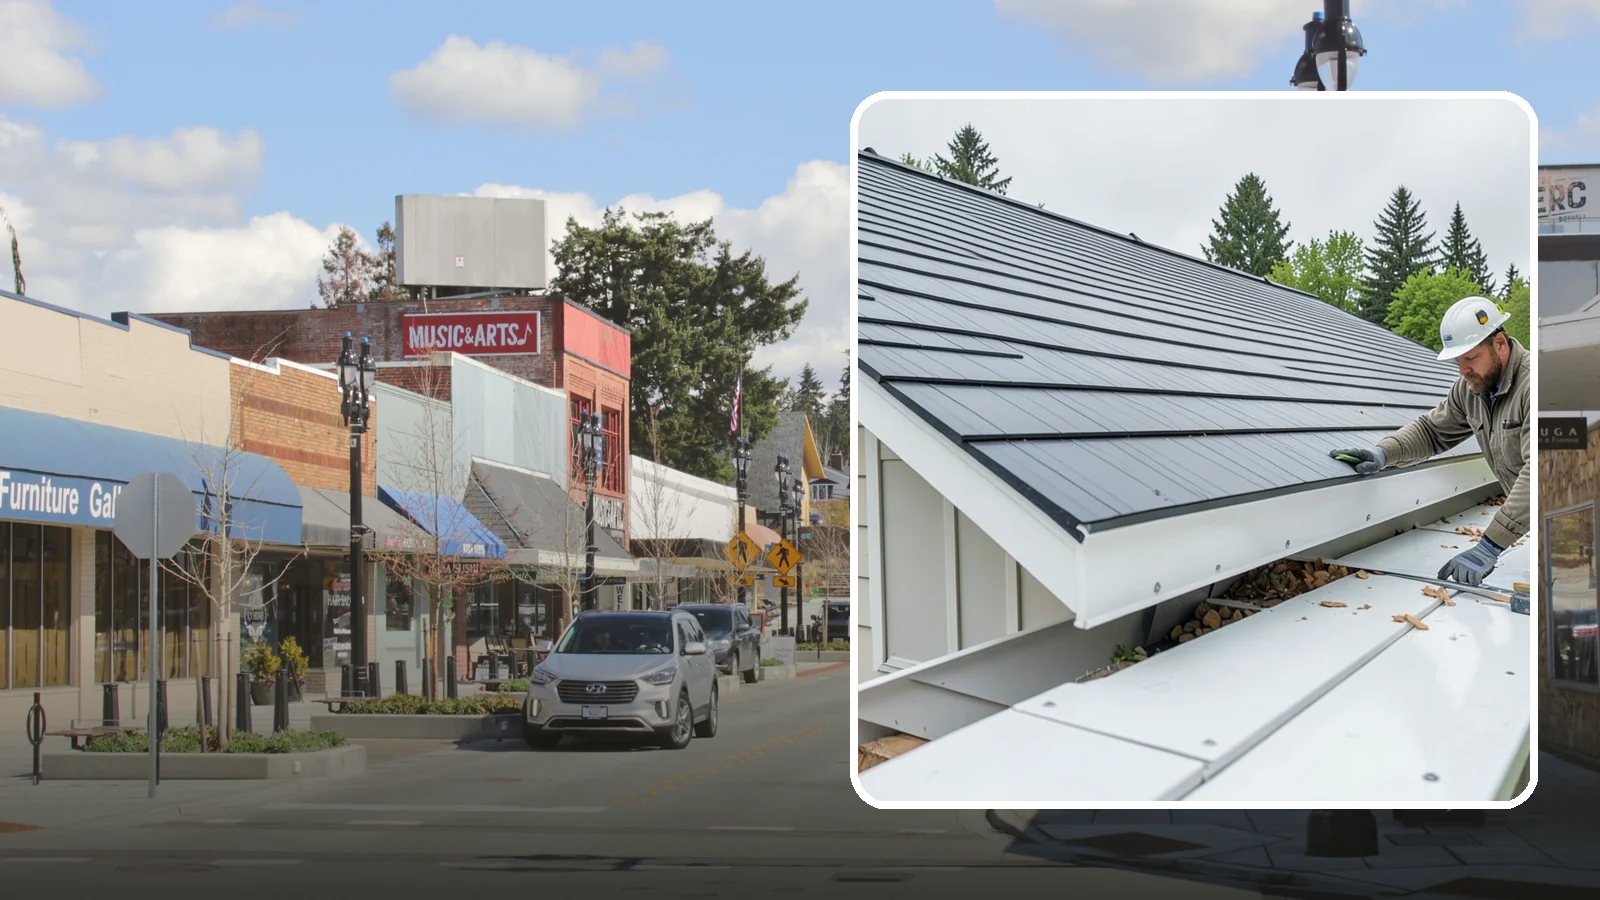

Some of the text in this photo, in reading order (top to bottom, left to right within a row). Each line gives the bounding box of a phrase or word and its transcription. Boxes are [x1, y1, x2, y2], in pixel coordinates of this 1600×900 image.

[0, 471, 122, 519] Furniture Gal
[454, 563, 480, 575] SUSHI
